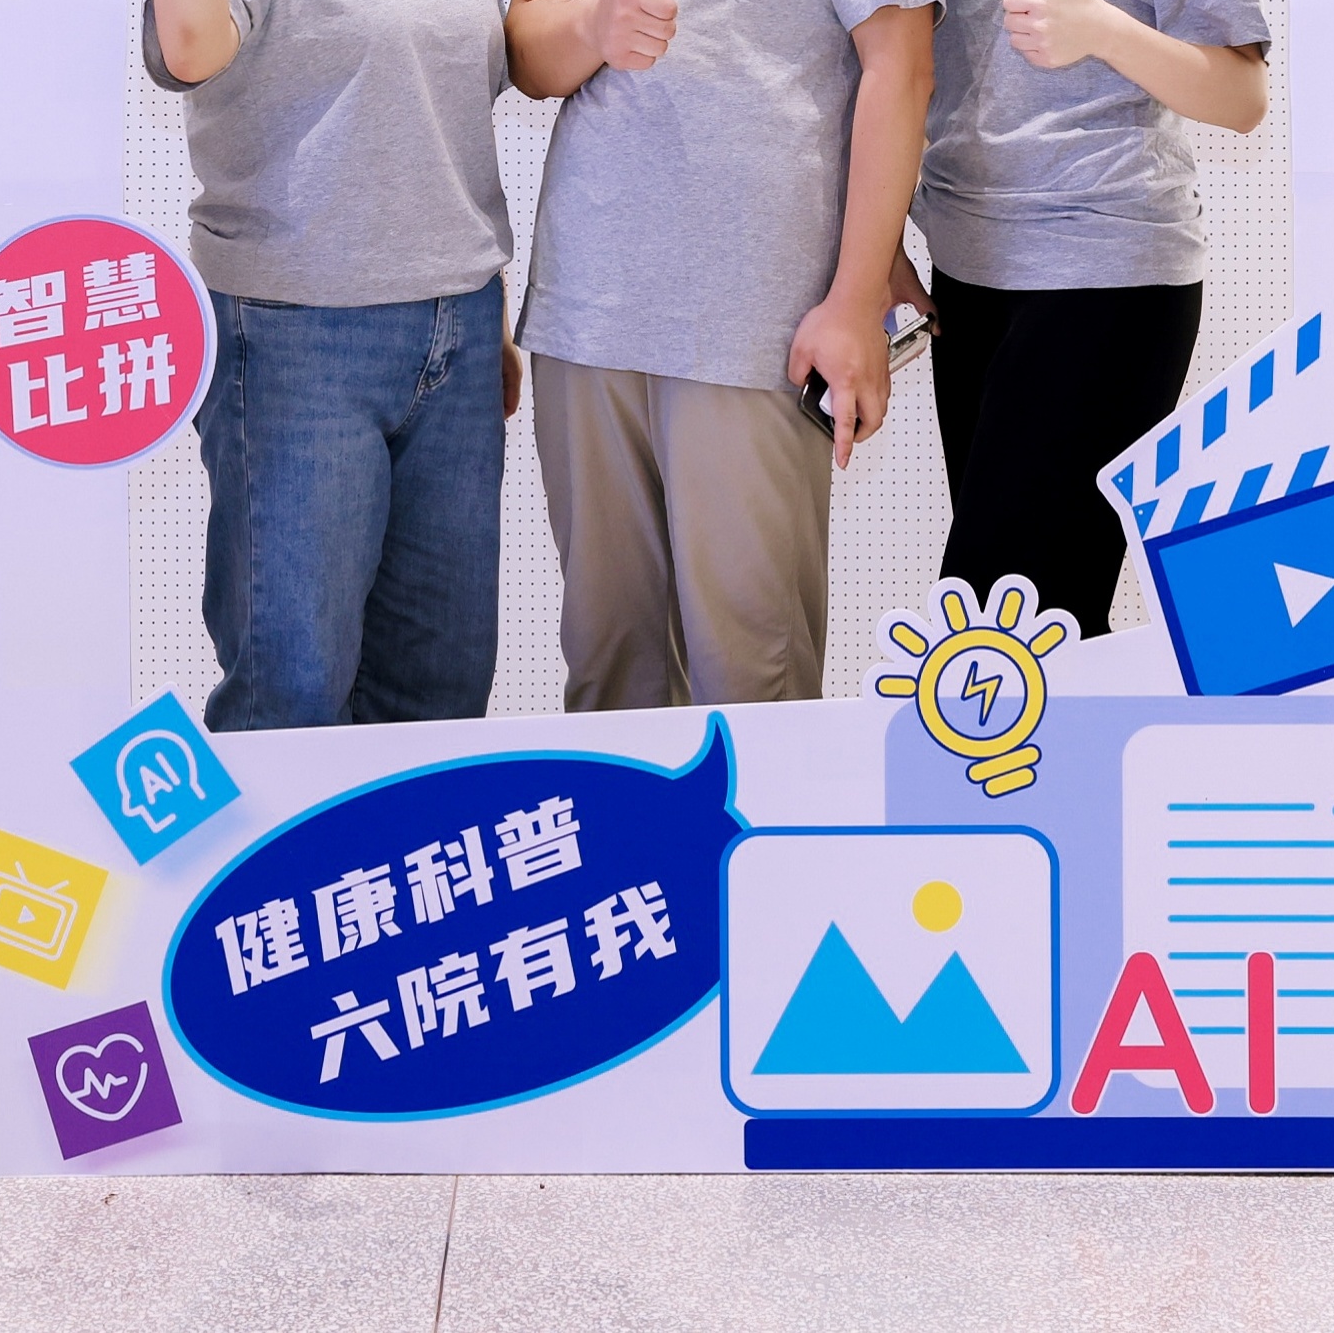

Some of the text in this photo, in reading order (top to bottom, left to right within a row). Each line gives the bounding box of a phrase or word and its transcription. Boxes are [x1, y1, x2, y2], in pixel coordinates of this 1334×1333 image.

[7, 333, 176, 434] 比拼
[139, 751, 181, 805] AI
[214, 795, 585, 998] 健康科普
[309, 880, 678, 1085] 六院有我
[1070, 950, 1276, 1116] AI
